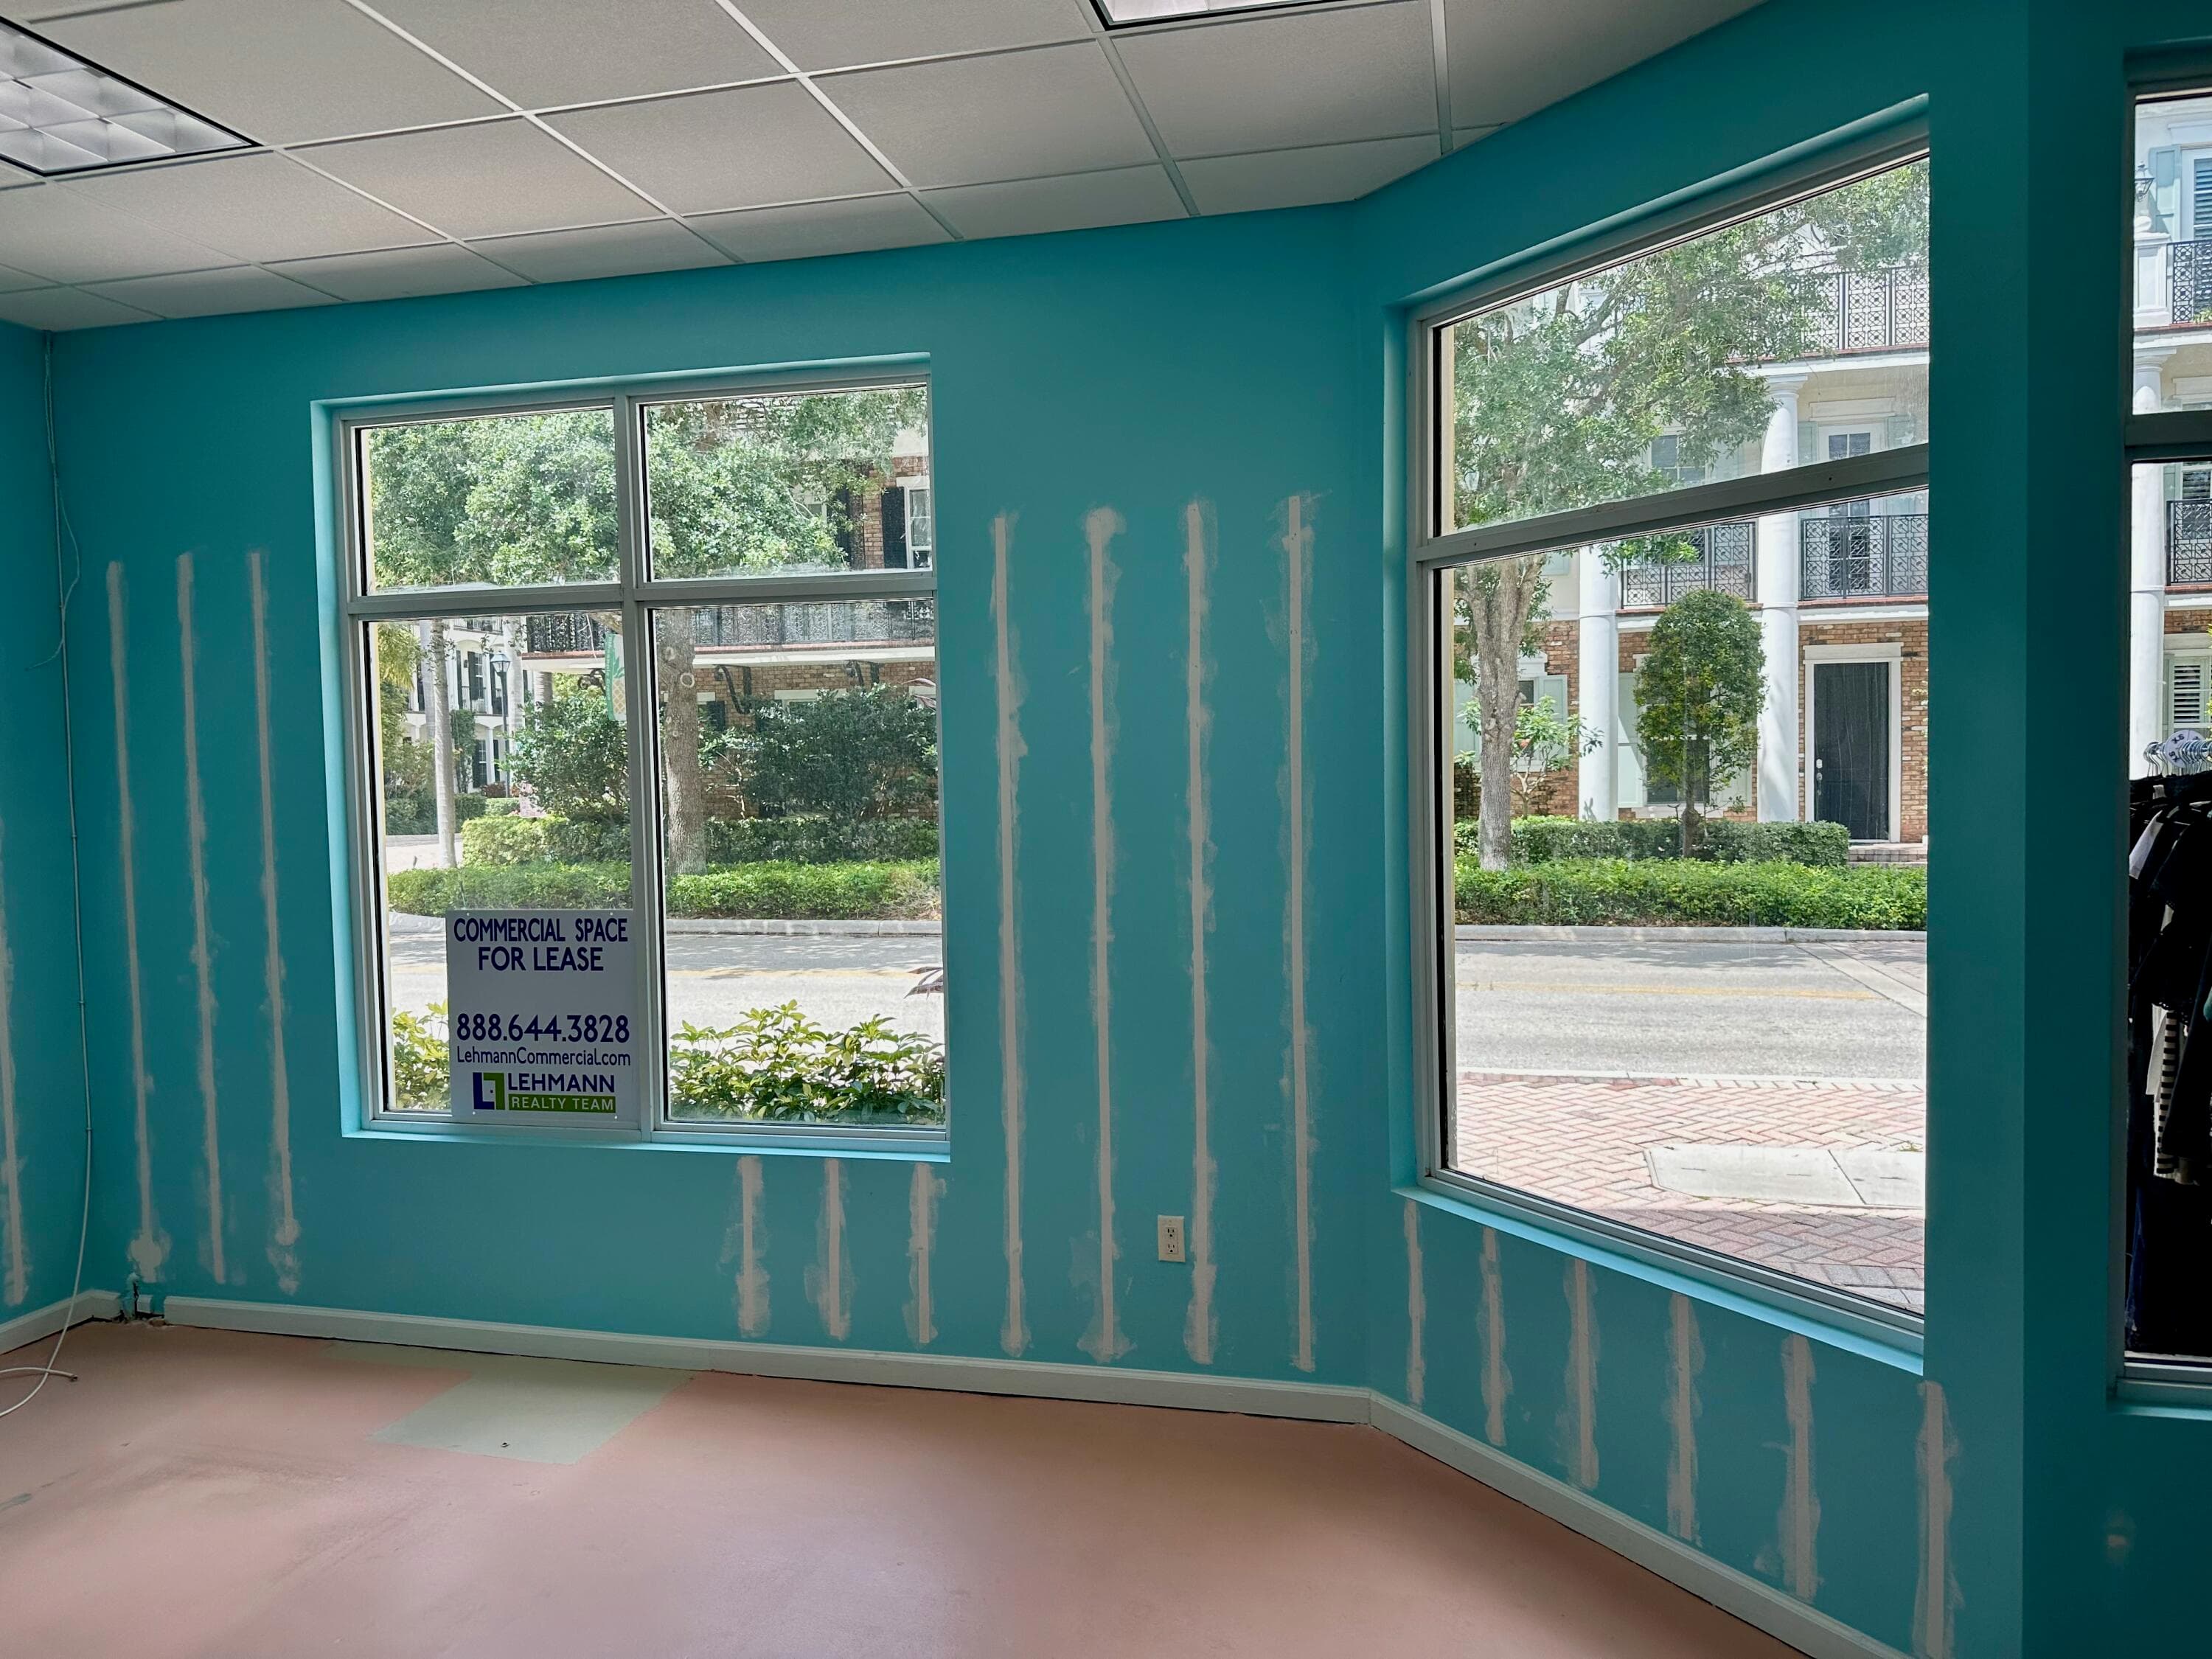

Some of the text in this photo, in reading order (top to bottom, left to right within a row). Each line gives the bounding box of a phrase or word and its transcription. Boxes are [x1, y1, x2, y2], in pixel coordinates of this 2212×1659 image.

[2171, 734, 2185, 744] XS
[453, 917, 628, 942] COMMERCIAL SPACE
[478, 946, 604, 971] FOR LEASE
[456, 1013, 630, 1043] 888.644.3828
[457, 1046, 631, 1066] LehmannCommercial.com
[508, 1073, 615, 1093] LEHMANN
[511, 1096, 613, 1110] REALTY TEAM
